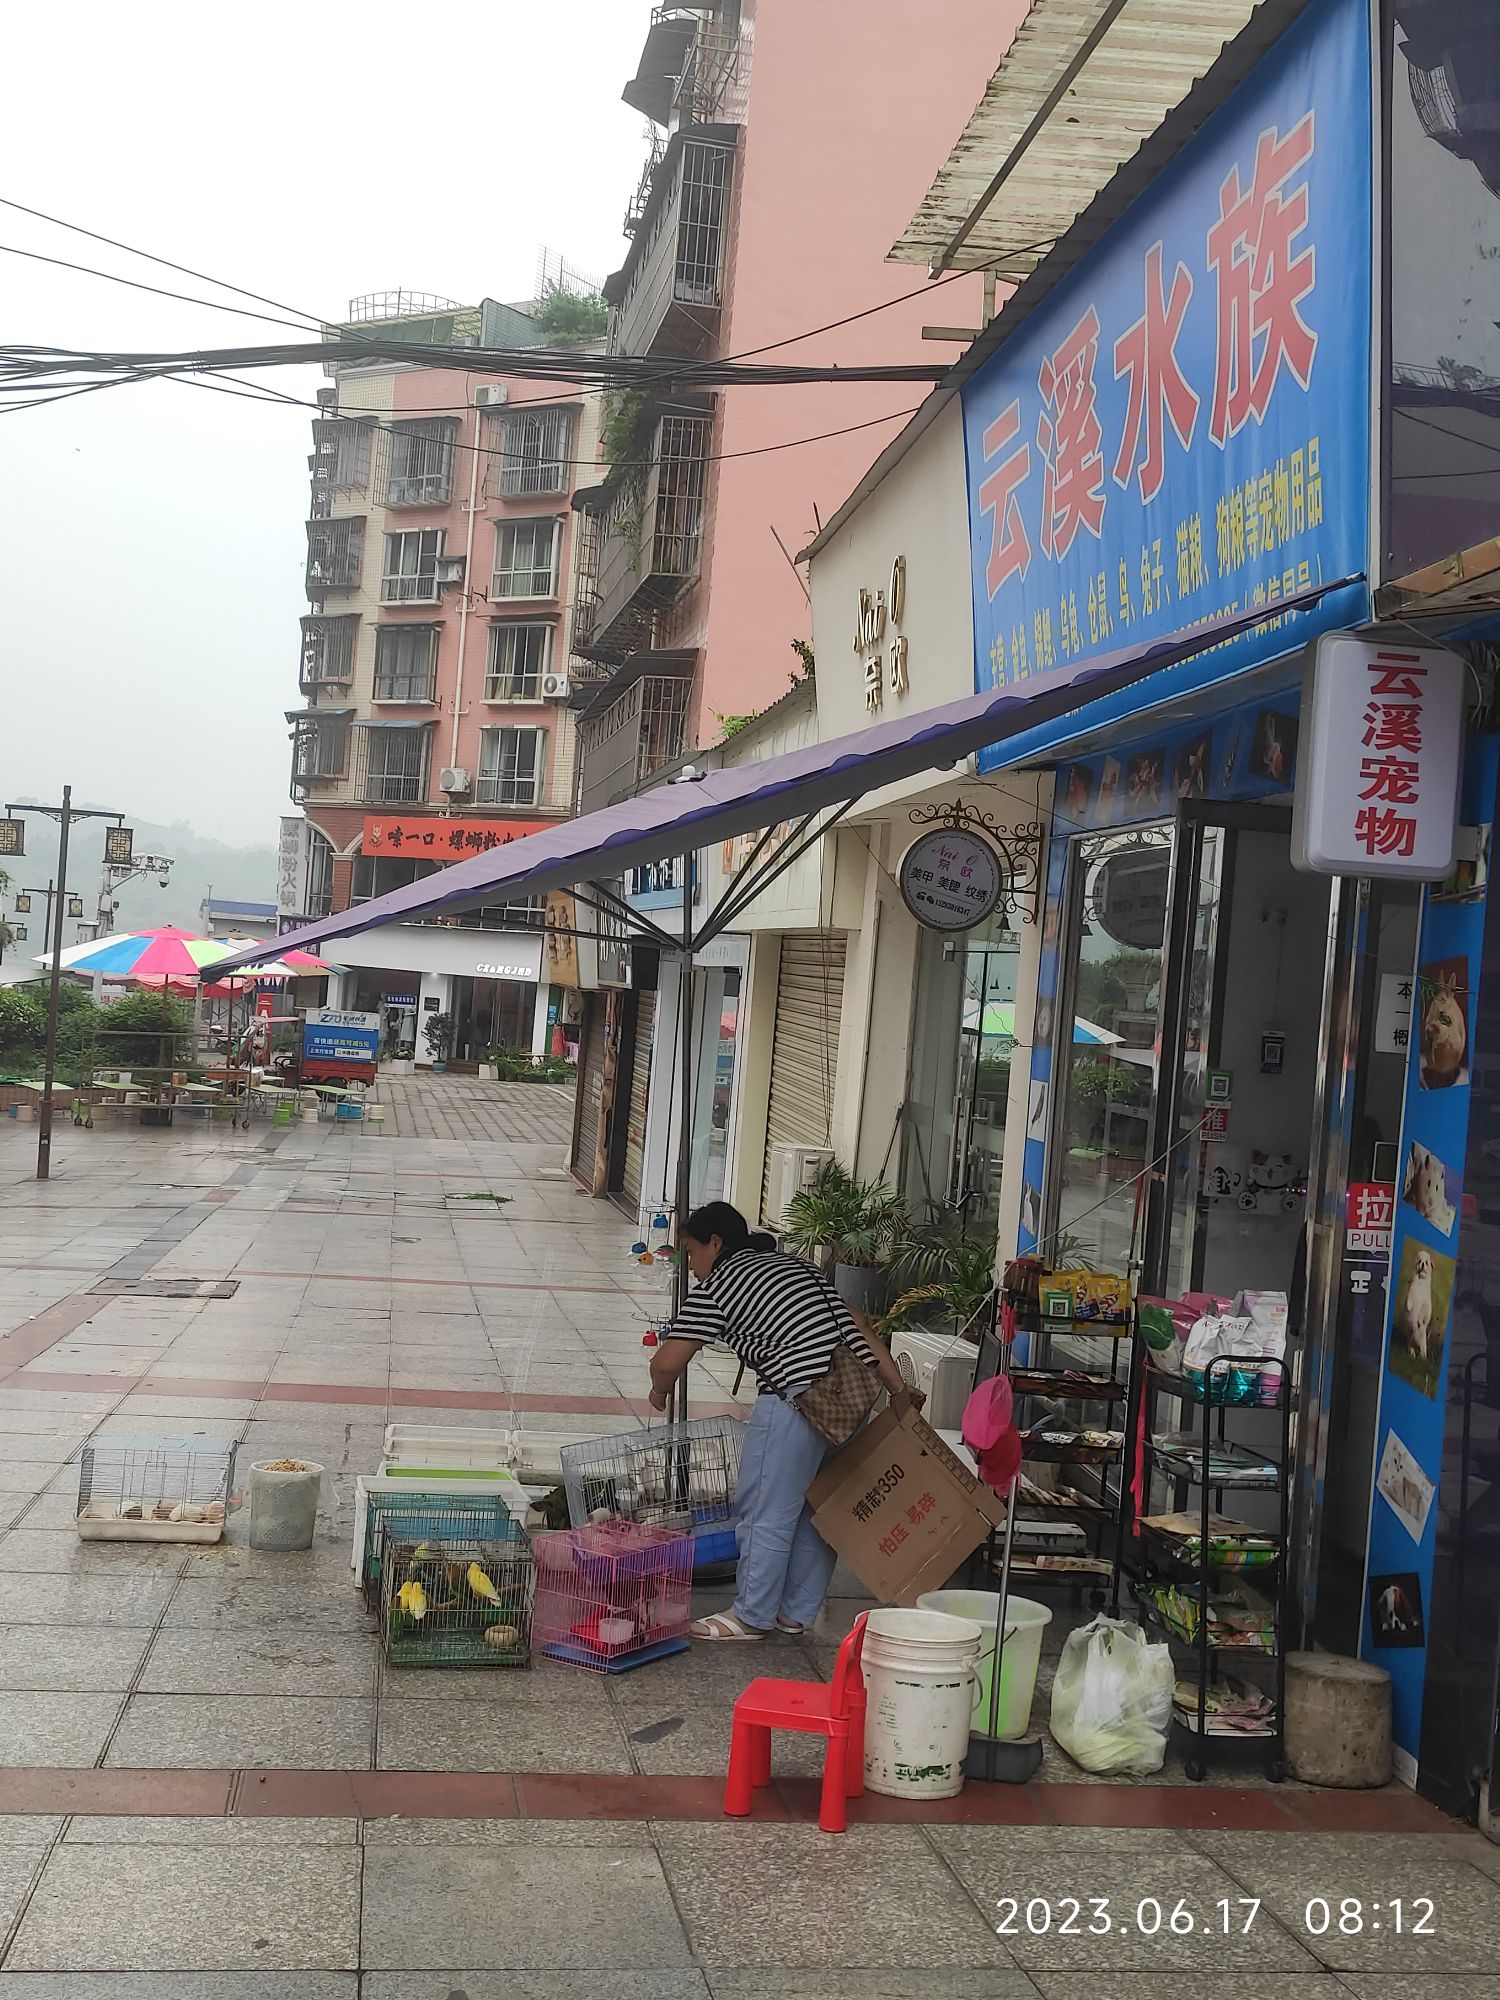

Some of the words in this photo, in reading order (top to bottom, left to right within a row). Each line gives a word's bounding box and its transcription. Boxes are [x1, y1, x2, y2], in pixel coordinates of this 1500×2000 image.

[978, 109, 1318, 602] 云溪水族
[1354, 652, 1428, 857] 云溪宠物
[280, 821, 299, 908] 螺蛳粉火锅
[910, 866, 934, 884] 美甲
[965, 884, 989, 903] 纹绣
[1201, 1131, 1226, 1140] PUSH
[1205, 1109, 1225, 1130] 推
[1357, 1188, 1392, 1229] 拉
[878, 1523, 910, 1558] 怕压
[904, 1491, 936, 1528] 易碎
